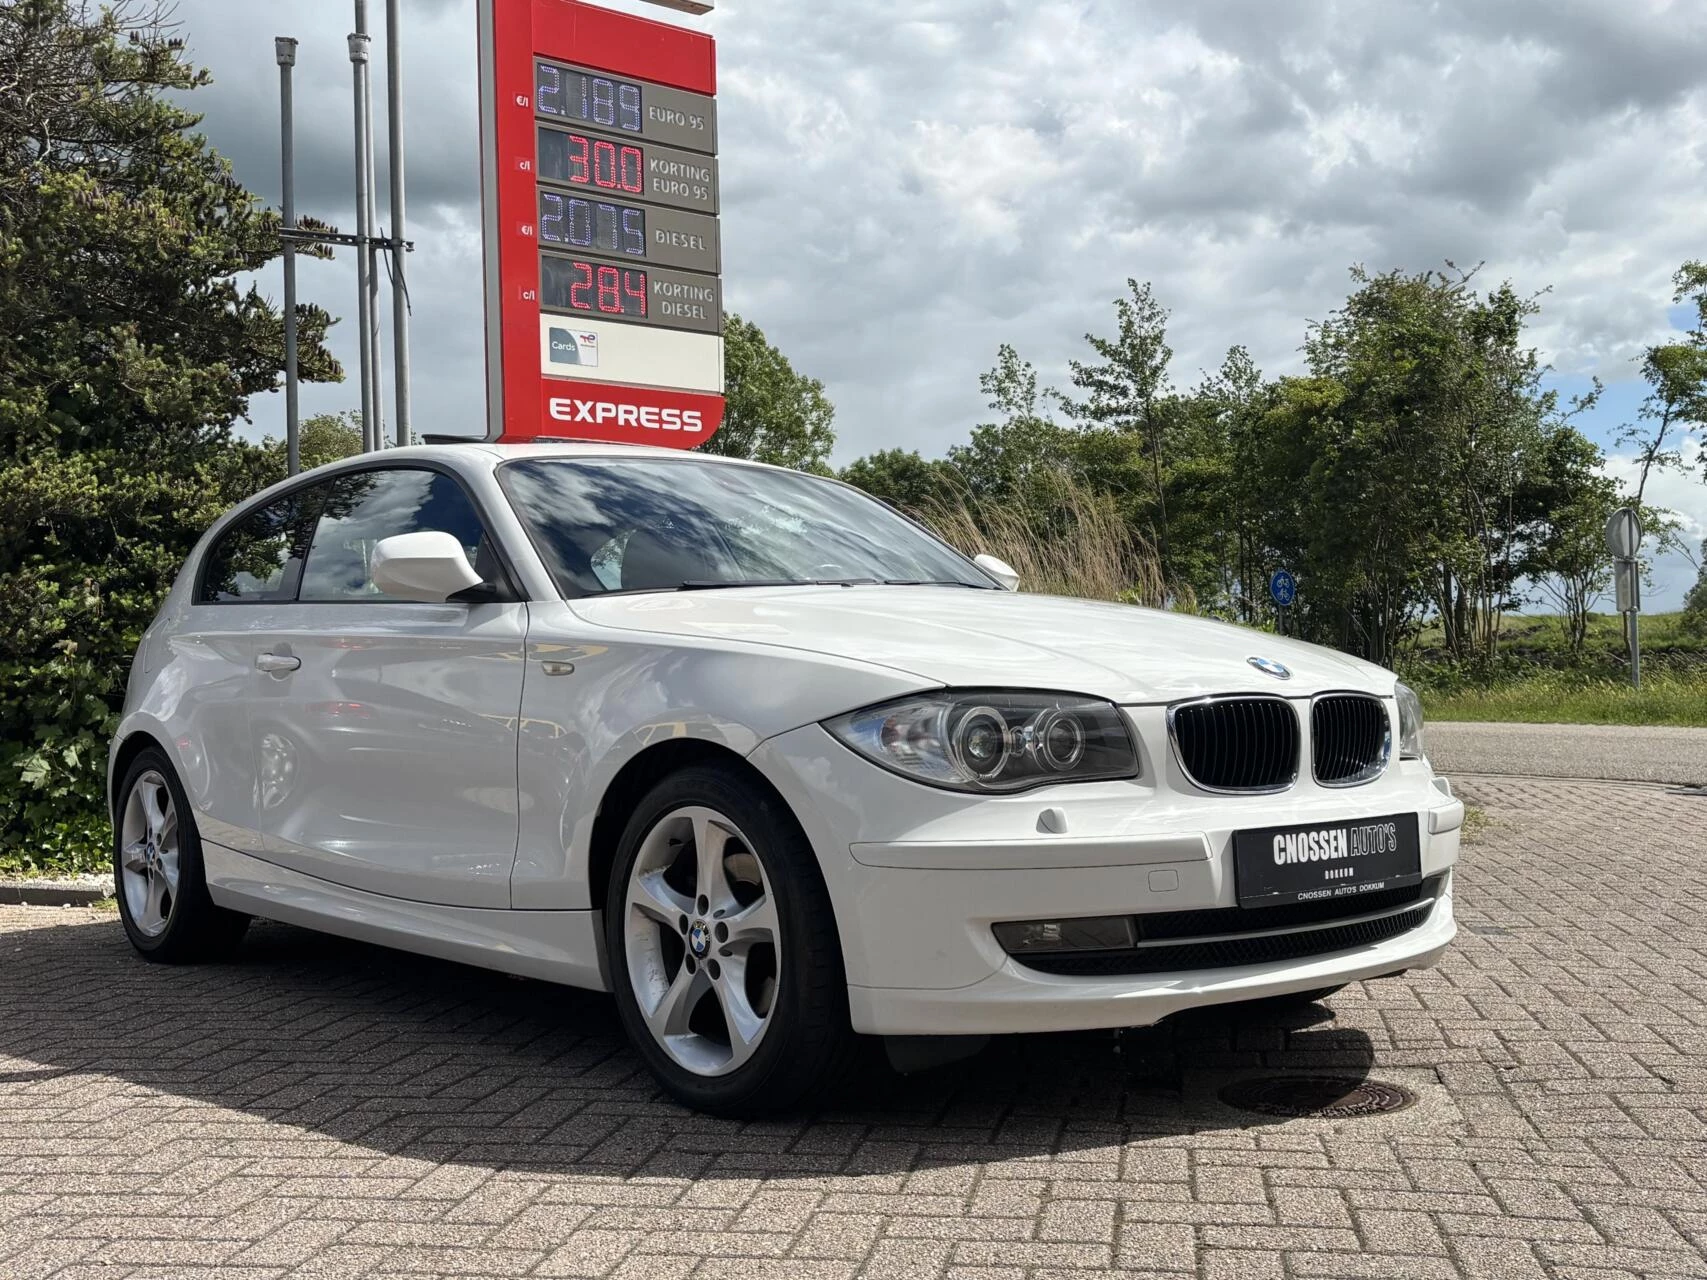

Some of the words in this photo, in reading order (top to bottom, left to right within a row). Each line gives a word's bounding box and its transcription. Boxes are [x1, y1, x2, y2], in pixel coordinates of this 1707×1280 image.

[538, 65, 640, 131] 2.189
[649, 106, 685, 125] EURO
[689, 115, 704, 131] 95
[569, 135, 642, 193] 30.0
[650, 159, 710, 182] KORTING
[653, 179, 689, 197] EURO
[693, 185, 708, 201] 95
[541, 193, 644, 255] 2.075
[655, 229, 706, 250] DIESEL
[570, 262, 646, 315] 28.4
[653, 280, 713, 302] KORTING
[662, 303, 707, 320] DIESEL
[552, 341, 576, 352] Cards
[549, 397, 703, 432] EXPRESS
[1273, 829, 1348, 865] CNOSSEN
[1350, 822, 1396, 857] AUTO'S
[1298, 889, 1331, 901] CNOSSEN
[1334, 886, 1357, 896] AUTO'S
[1359, 882, 1385, 892] DOKKUM
